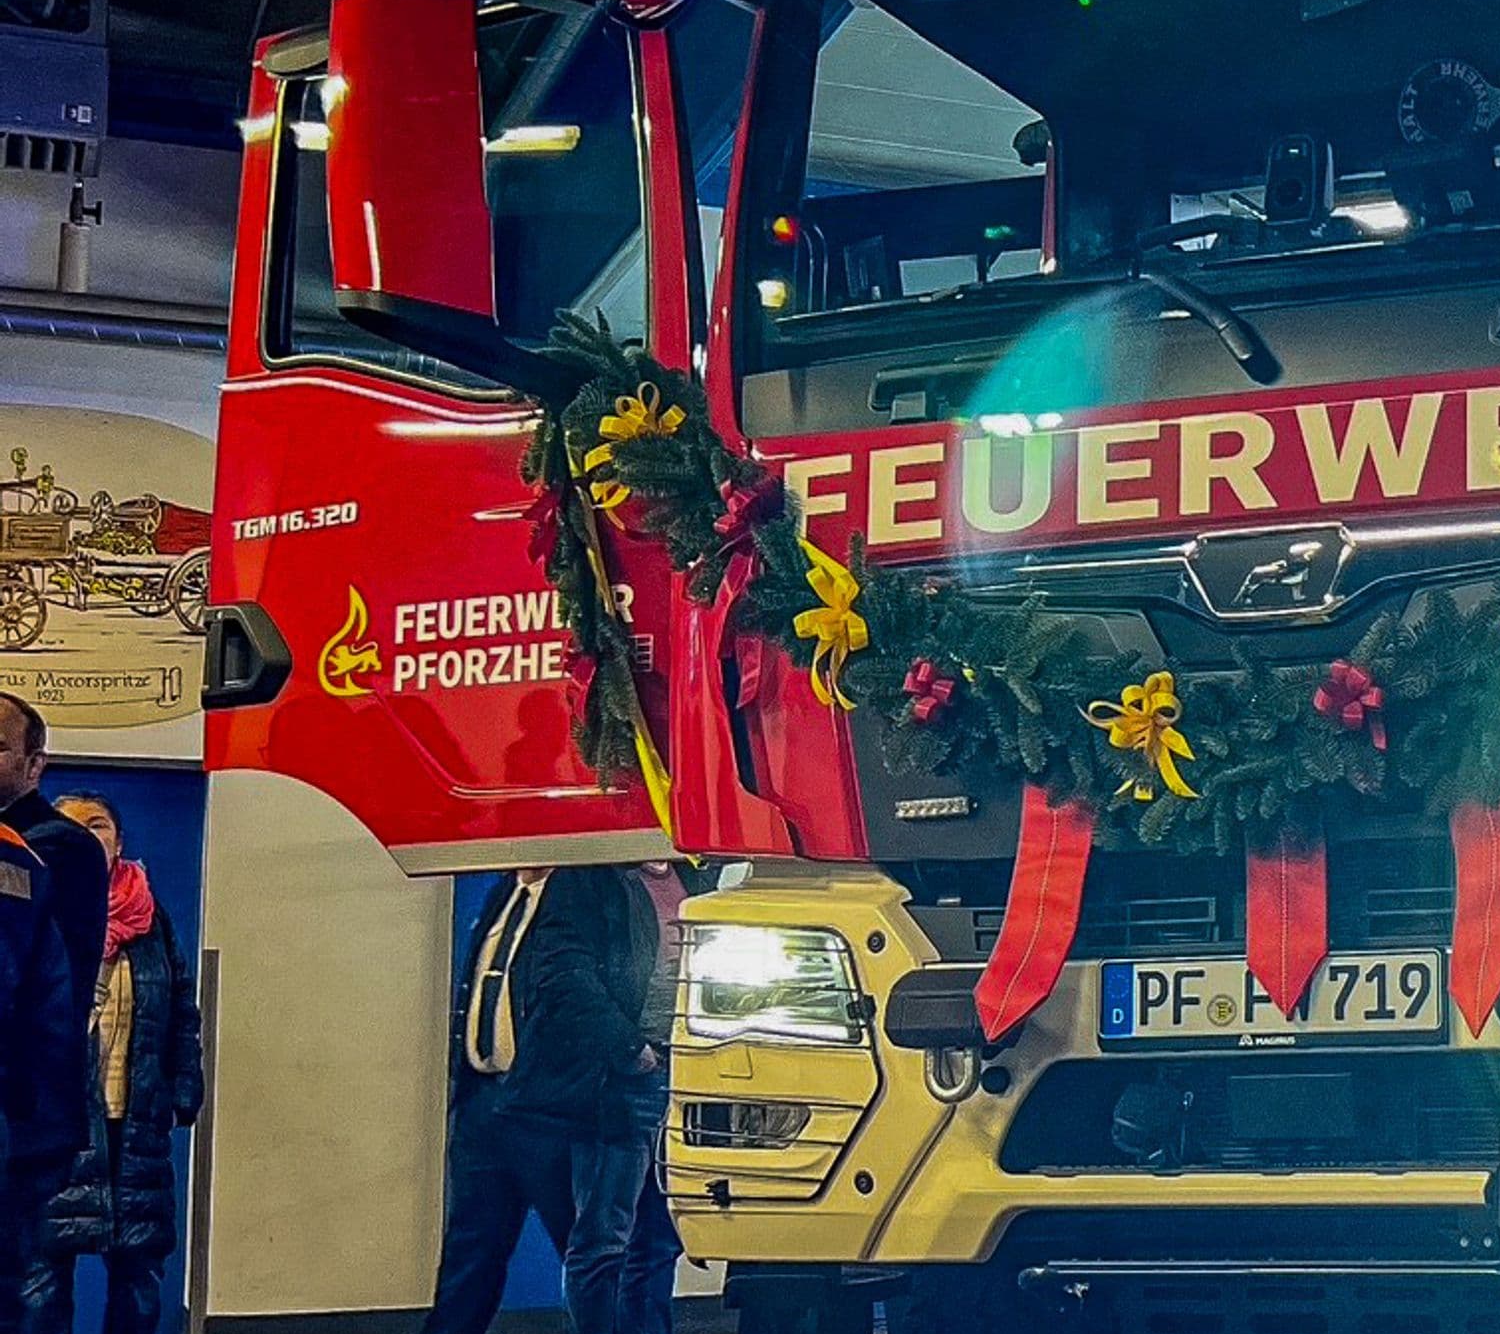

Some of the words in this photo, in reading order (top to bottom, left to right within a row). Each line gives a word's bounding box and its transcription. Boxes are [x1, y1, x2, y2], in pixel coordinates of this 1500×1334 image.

[231, 515, 277, 541] TGM
[394, 583, 635, 644] FEUERWR
[35, 671, 152, 692] Motorspritze
[393, 641, 572, 692] PFORZHE
[1137, 969, 1206, 1026] PF
[1327, 962, 1433, 1021] 719
[1113, 1007, 1124, 1023] D
